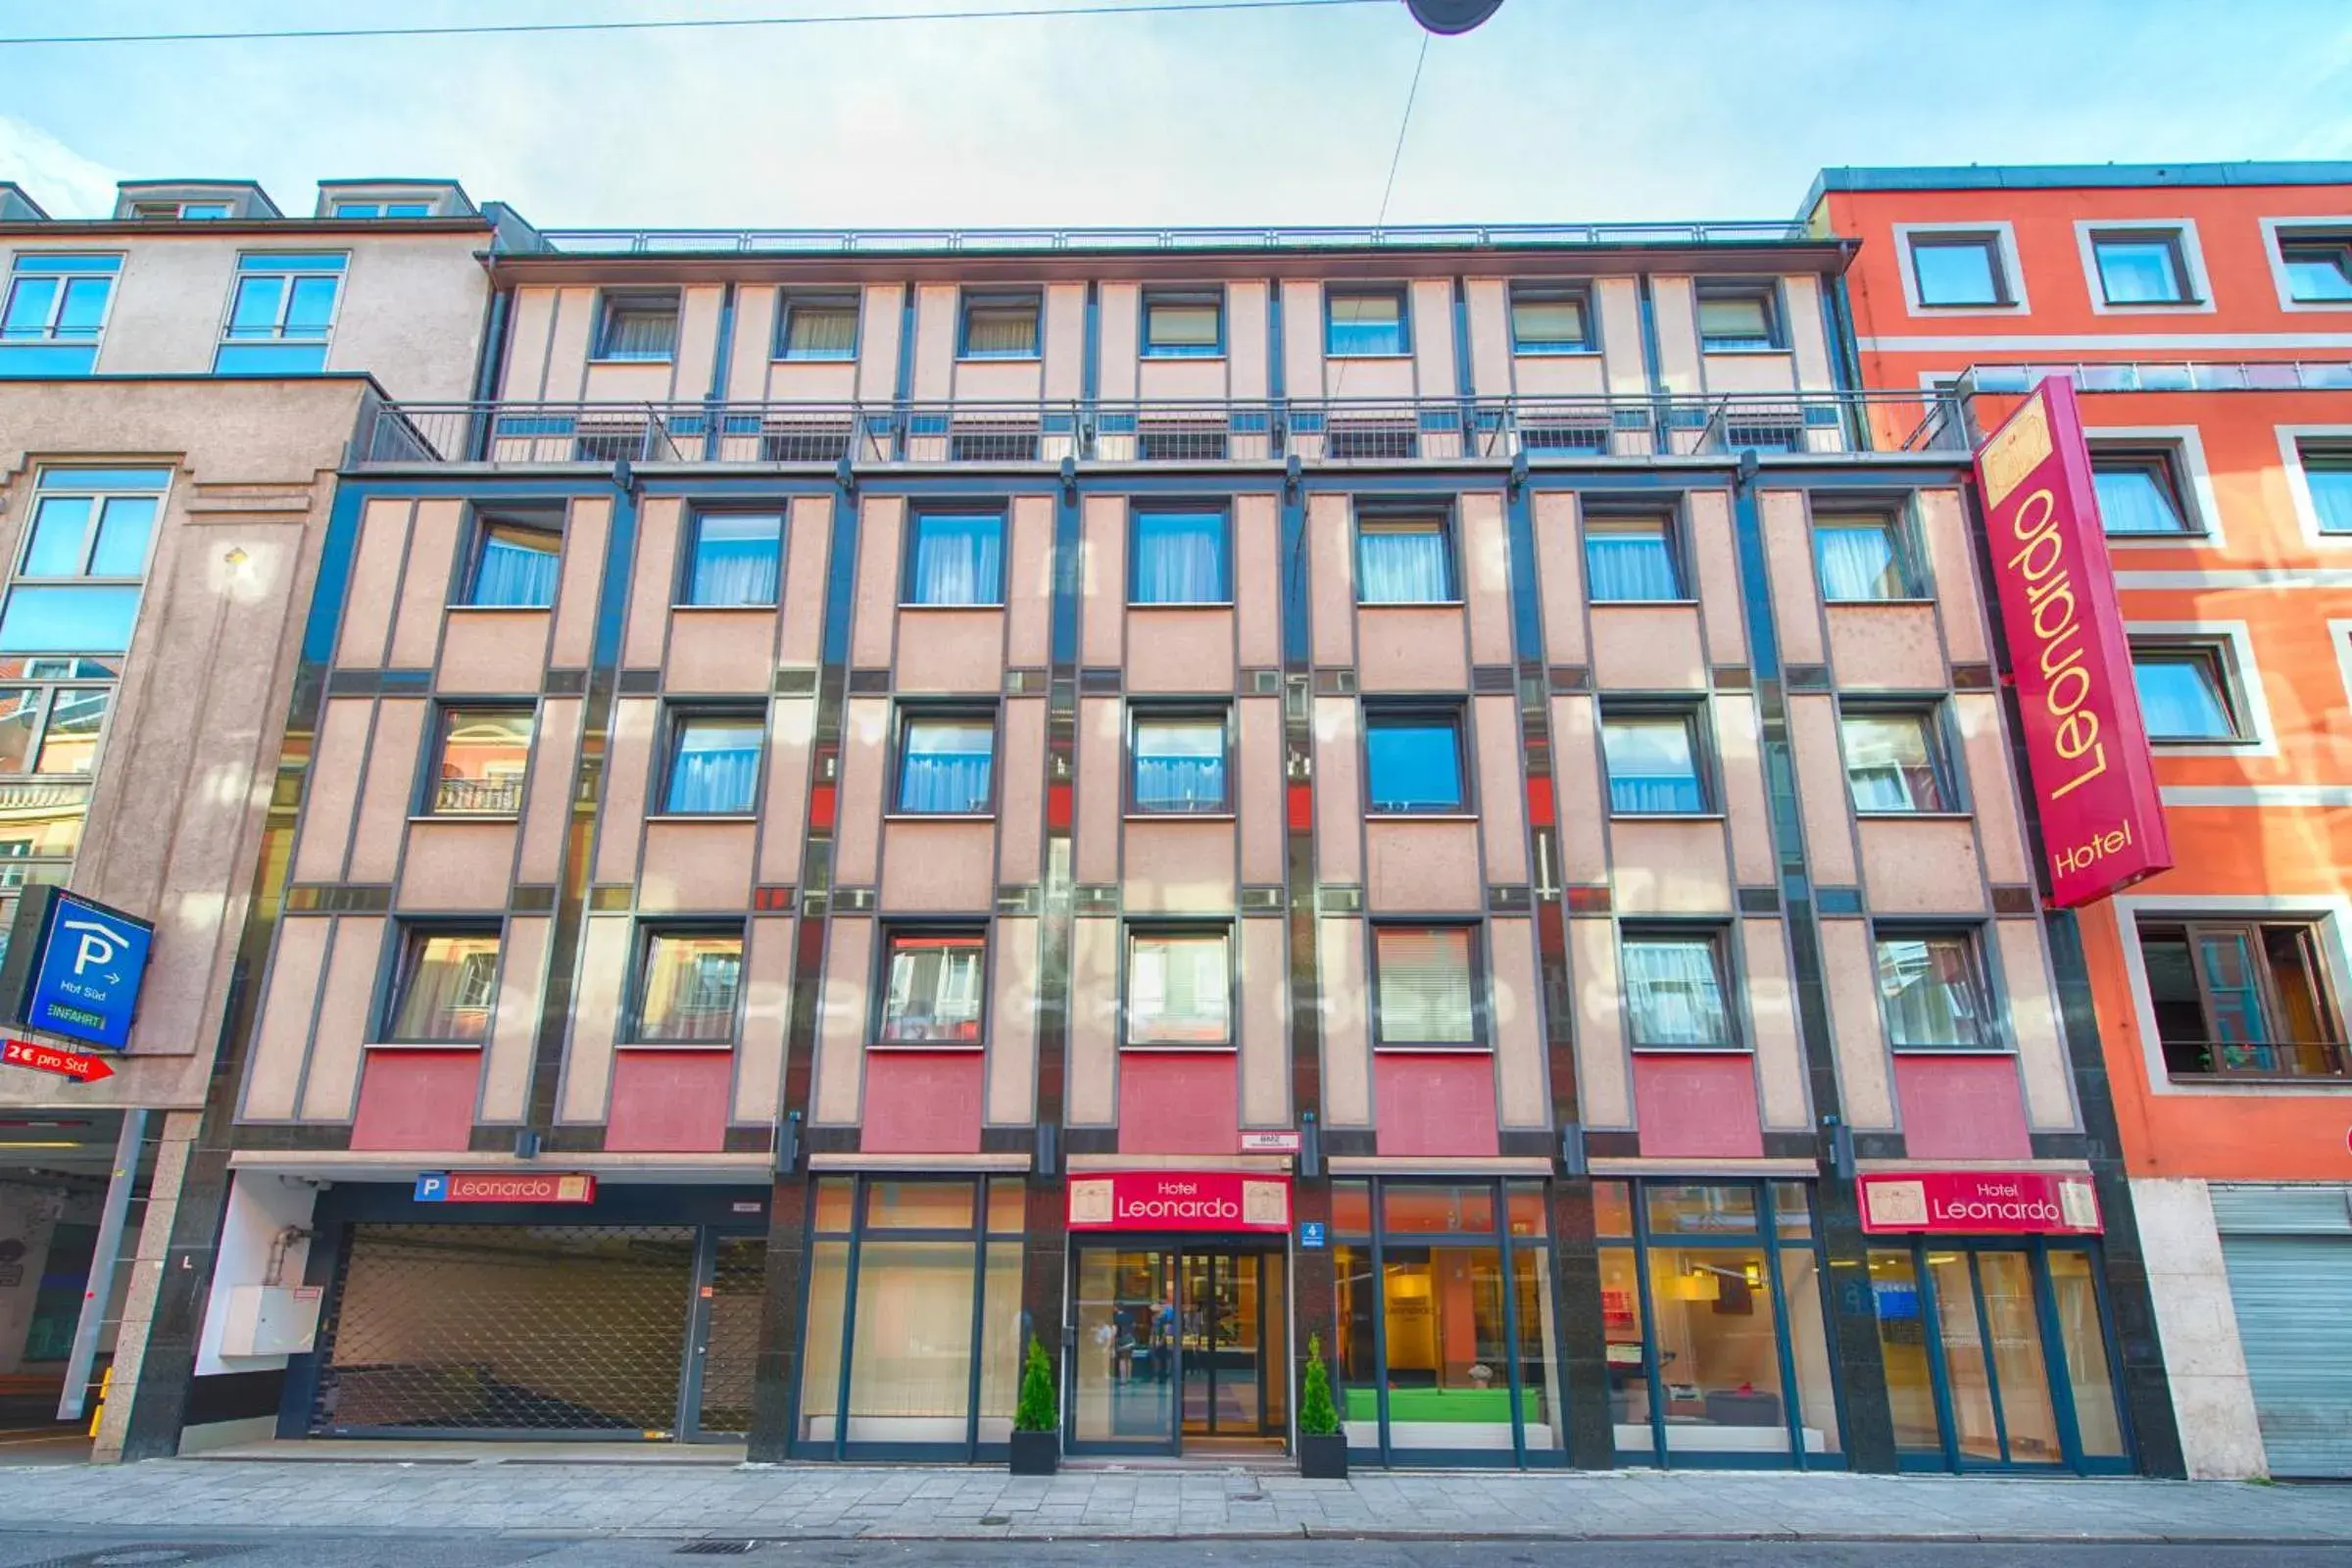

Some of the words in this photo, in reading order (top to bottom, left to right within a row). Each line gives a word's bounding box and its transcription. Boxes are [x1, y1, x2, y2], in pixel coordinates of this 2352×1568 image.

[2009, 489, 2106, 800] Leonardo
[2054, 819, 2132, 879] Hotel
[74, 935, 114, 974] P
[37, 1054, 61, 1067] pro
[423, 1179, 440, 1196] P
[453, 1178, 551, 1197] Leonardo
[1157, 1182, 1197, 1195] Hotel
[1977, 1183, 2019, 1197] Hotel
[1118, 1197, 1239, 1218] Leonardo
[1935, 1199, 2059, 1219] Leonardo
